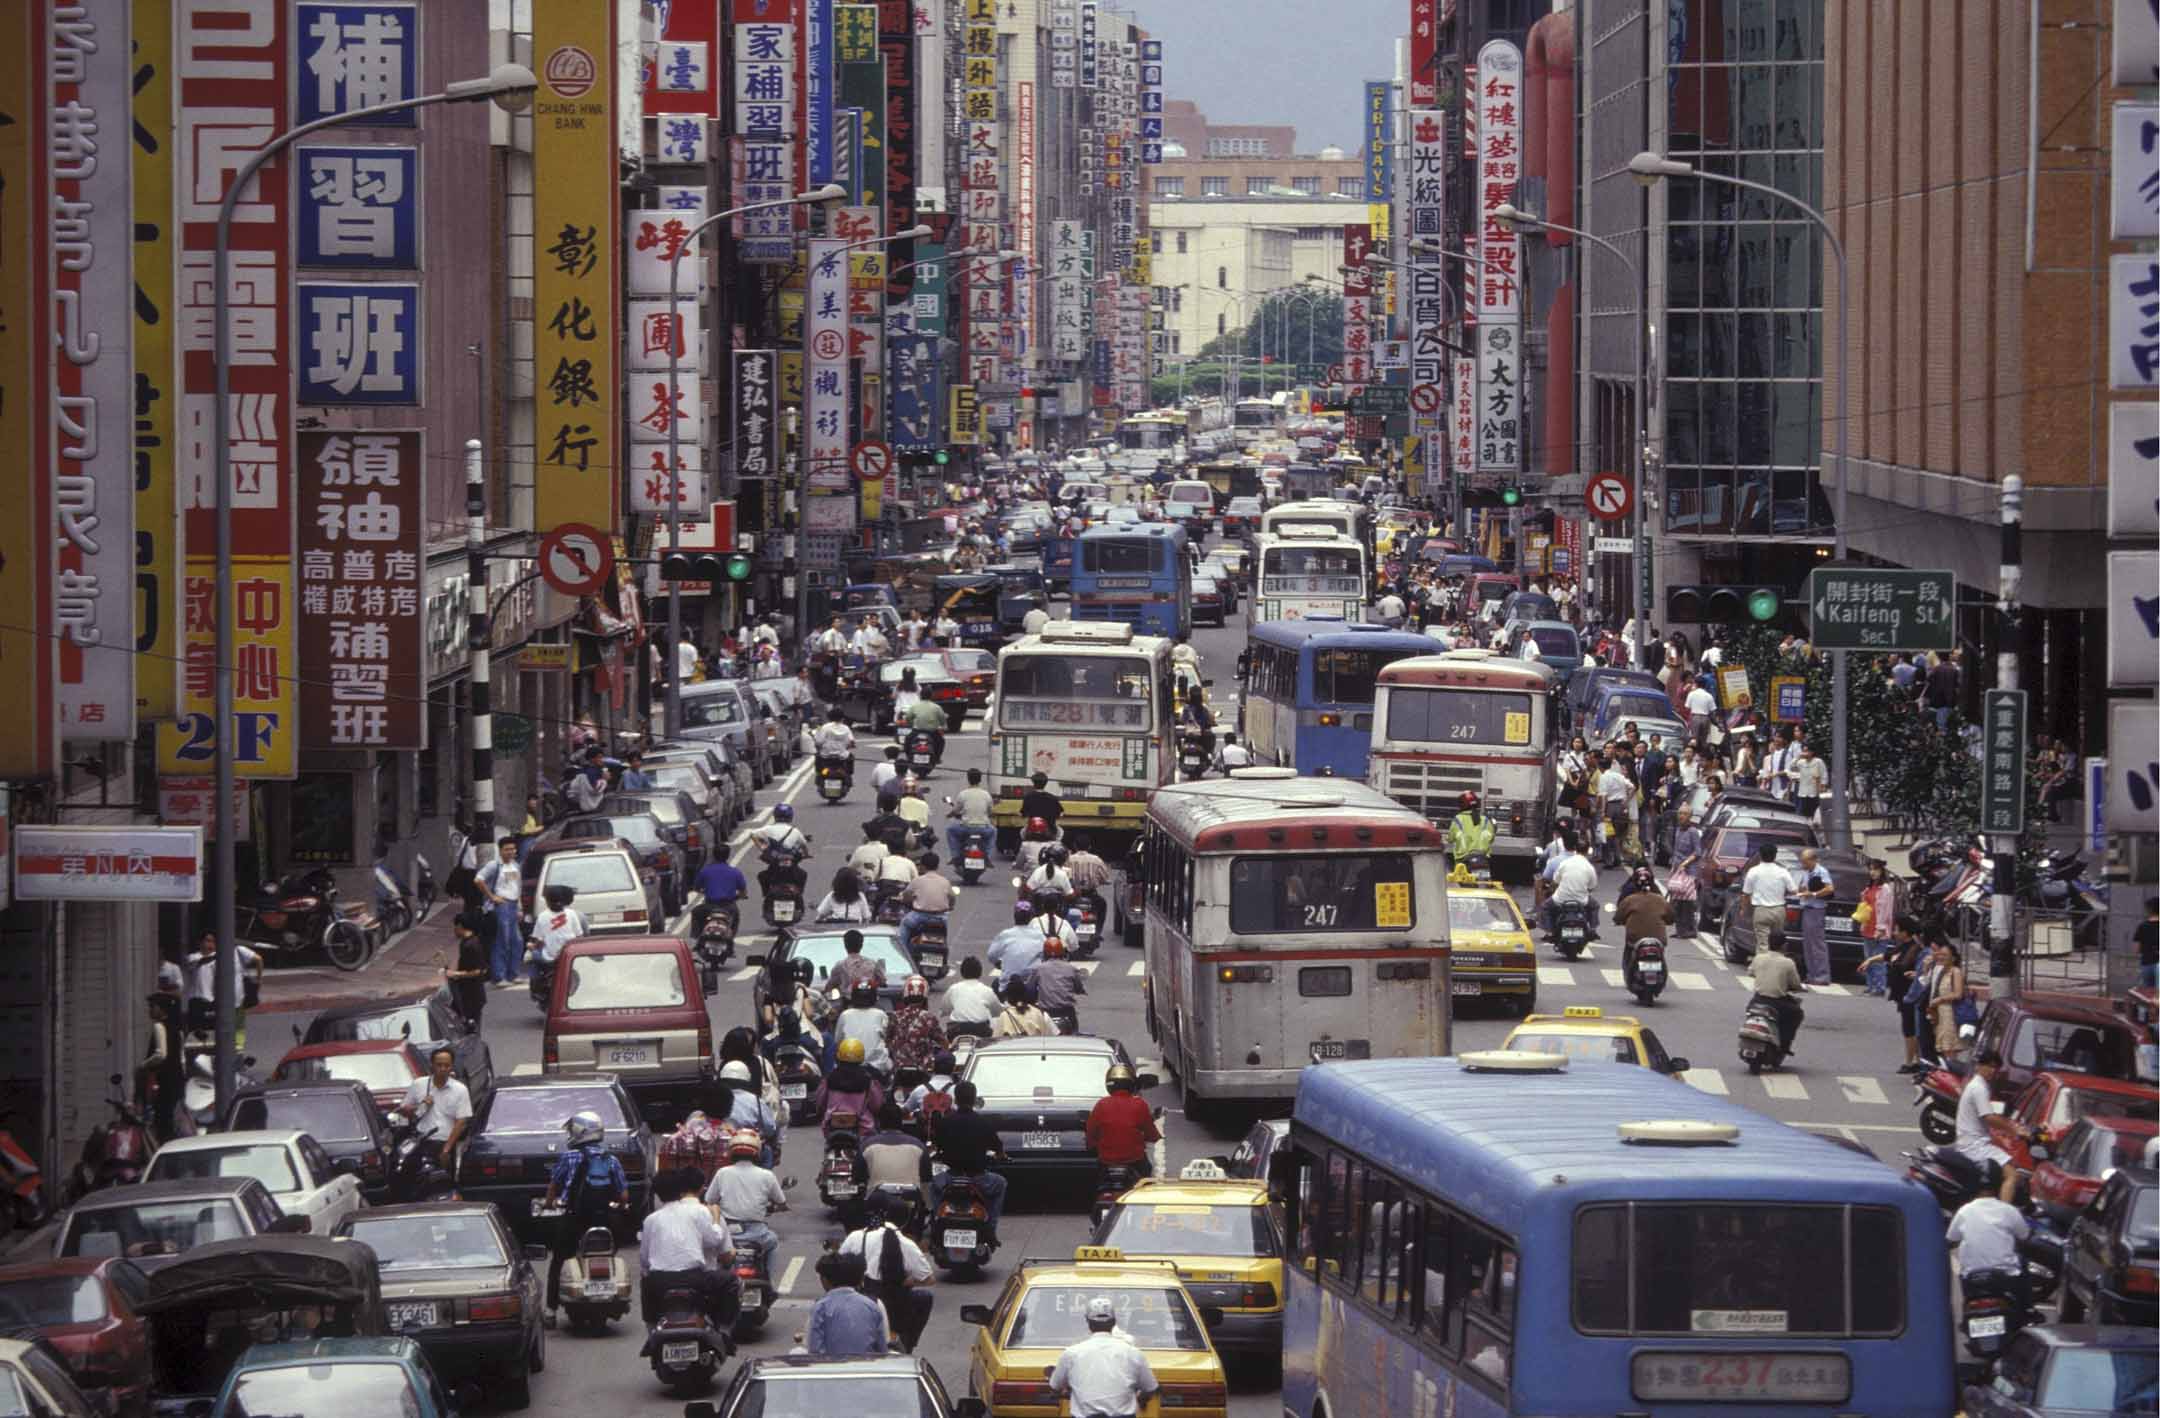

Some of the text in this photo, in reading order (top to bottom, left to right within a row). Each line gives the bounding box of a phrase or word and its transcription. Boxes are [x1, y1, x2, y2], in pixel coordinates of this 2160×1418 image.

[537, 104, 603, 115] CHANG HWA
[555, 118, 585, 129] BANK
[1485, 76, 1517, 158] 紅樓夢
[308, 13, 403, 395] 補習班
[1413, 147, 1440, 385] 光統圖書百貨公司
[546, 223, 599, 472] 彰化銀行
[1488, 357, 1513, 417] 大方
[742, 354, 769, 476] 建弘書局
[1482, 419, 1499, 464] 公司
[1500, 419, 1517, 464] 圖書
[314, 435, 401, 541] 領袖
[303, 550, 417, 581] 高普考
[303, 586, 417, 616] 權威特考
[1826, 581, 1941, 602] 開封街一段
[237, 577, 281, 700] 中心
[1829, 606, 1940, 627] Kaifeng St.
[330, 622, 390, 745] 補習班
[176, 712, 279, 763] 2F
[1450, 725, 1477, 738] 247
[1993, 709, 2014, 828] 重慶南路一段
[1304, 905, 1338, 926] 247
[1568, 1008, 1596, 1016] TAXI
[1082, 1249, 1119, 1259] TAXI
[1701, 1356, 1775, 1387] 237
